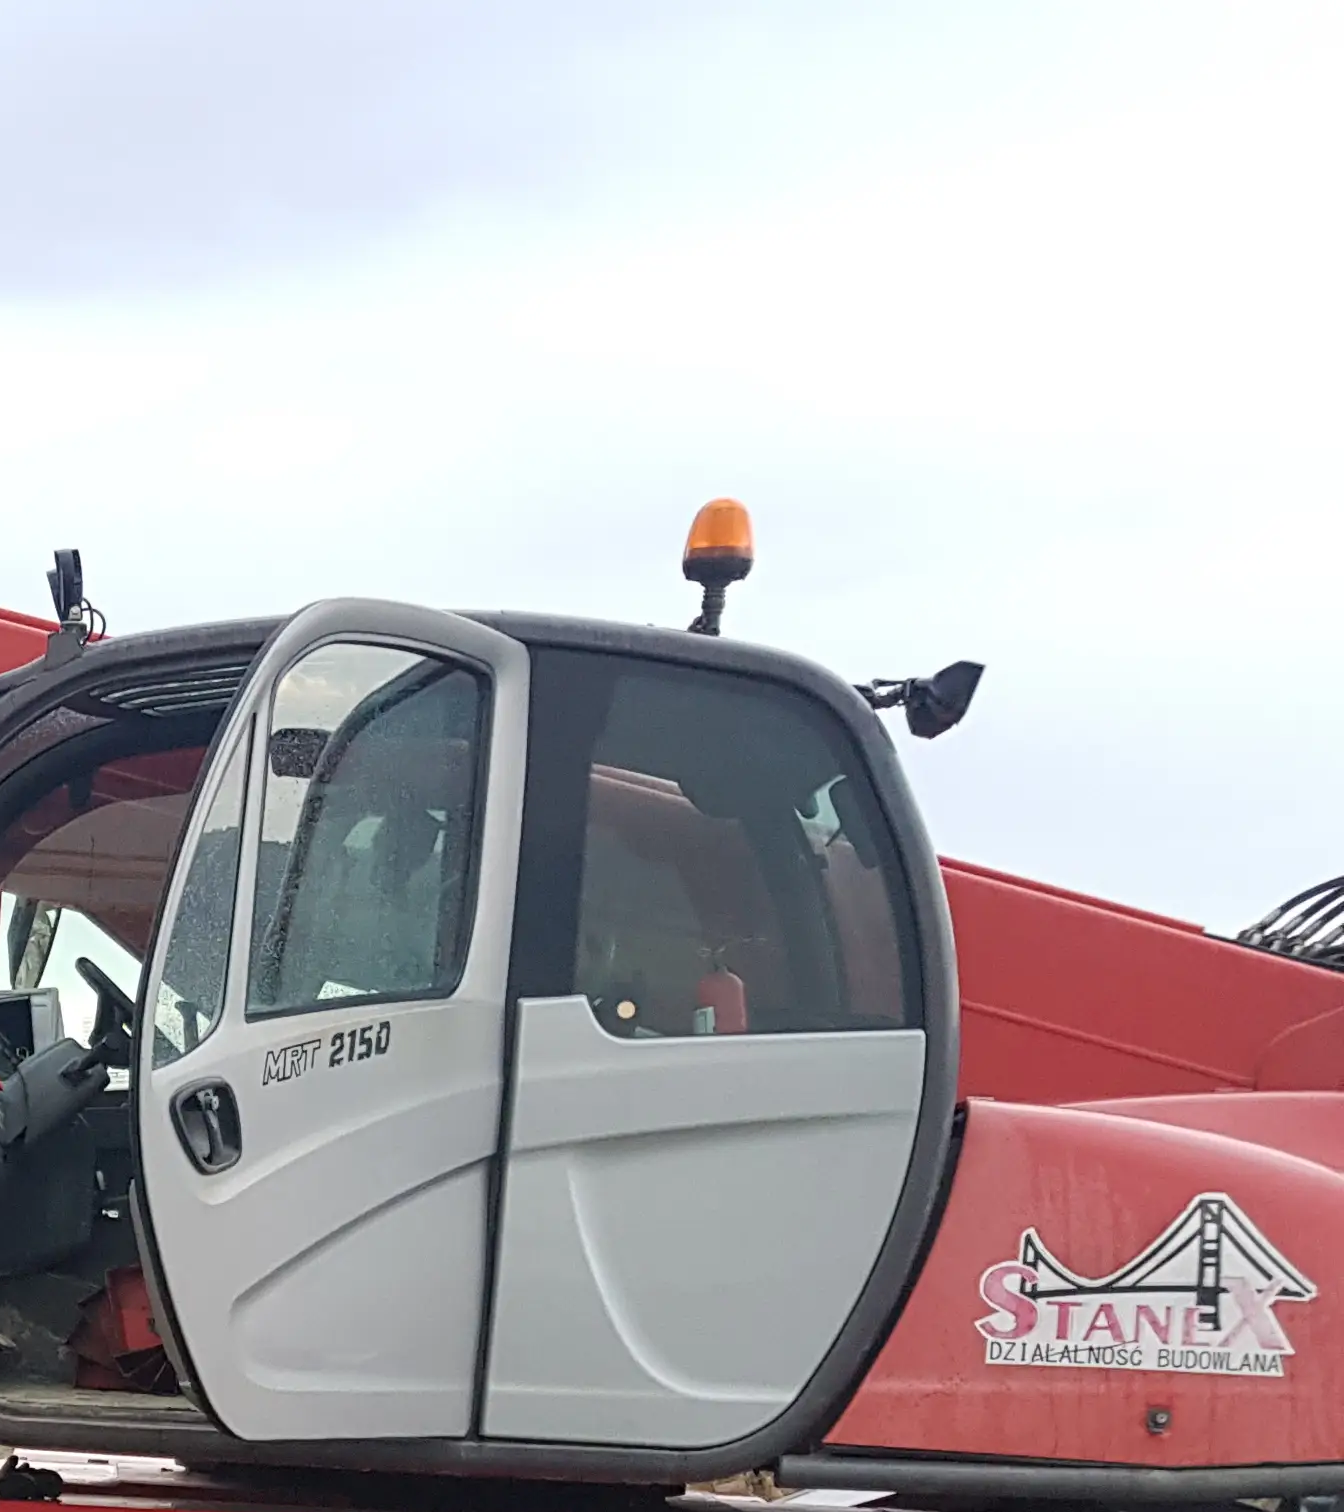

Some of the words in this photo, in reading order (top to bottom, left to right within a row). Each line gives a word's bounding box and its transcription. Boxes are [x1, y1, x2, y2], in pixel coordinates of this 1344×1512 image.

[262, 1038, 321, 1086] MRT
[328, 1021, 391, 1068] 2150
[979, 1264, 1286, 1350] STANEX
[988, 1340, 1143, 1368] DZIAŁALNOŚĆ
[1157, 1349, 1283, 1374] BUDOWLANA
